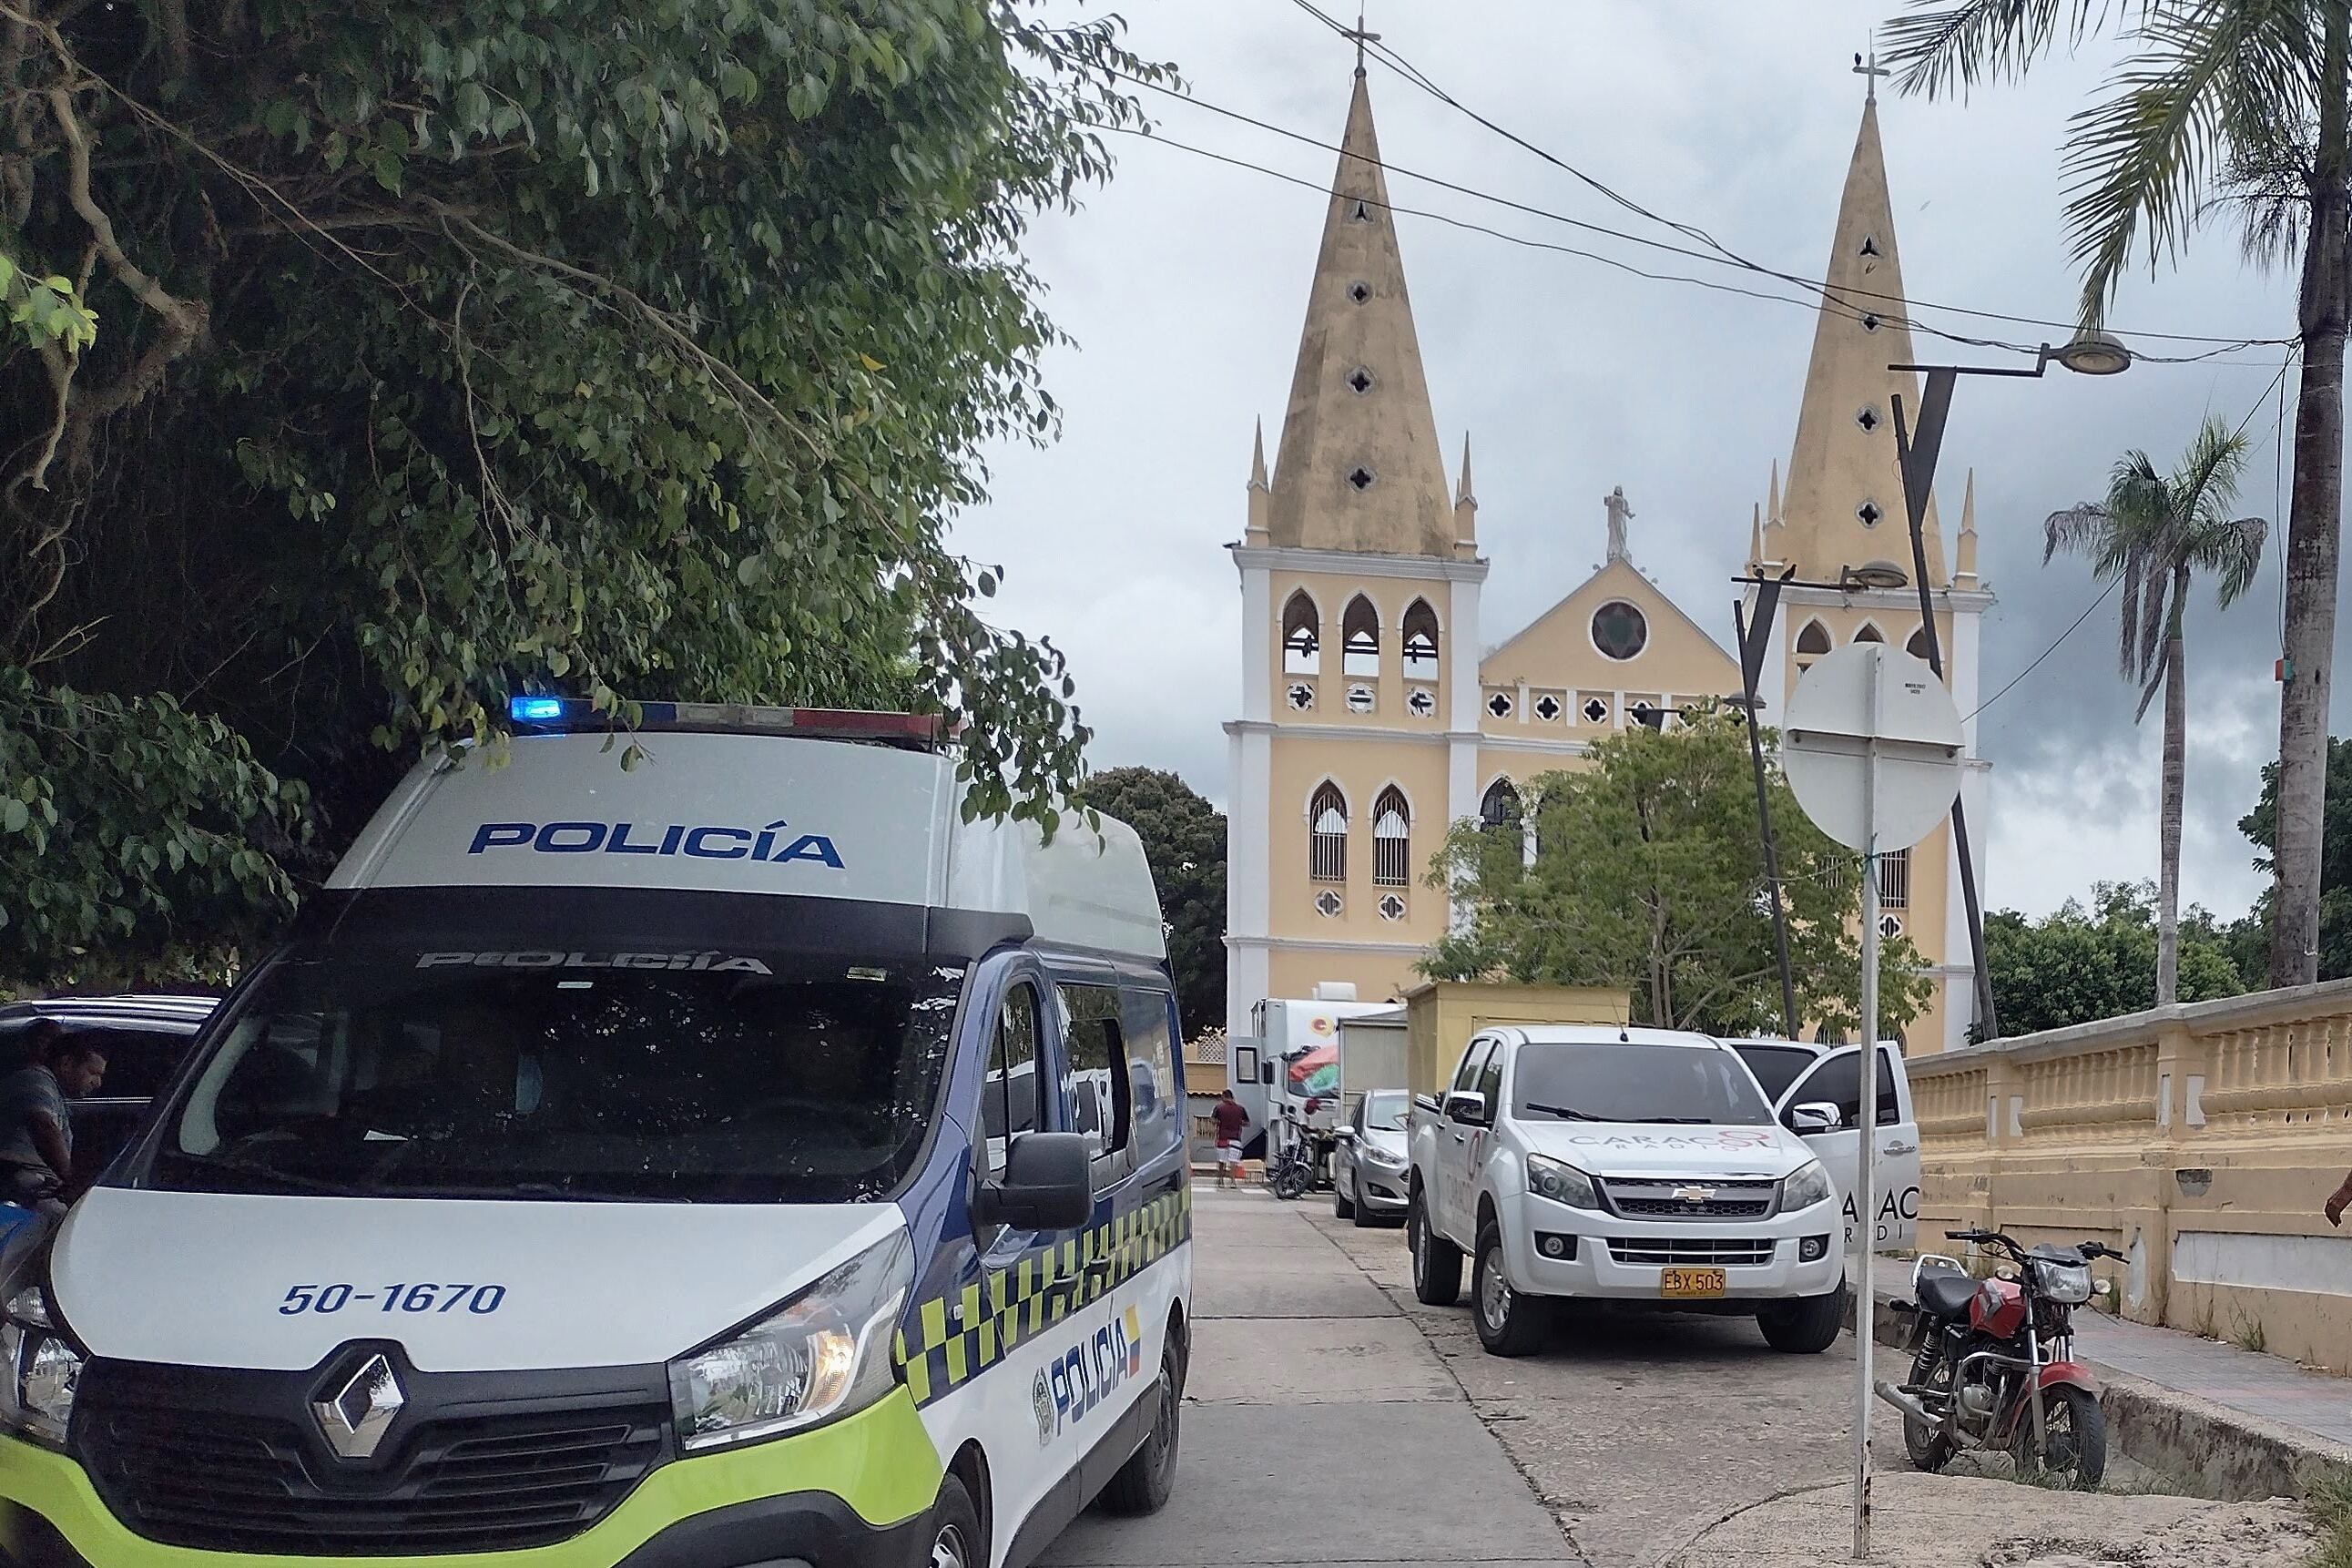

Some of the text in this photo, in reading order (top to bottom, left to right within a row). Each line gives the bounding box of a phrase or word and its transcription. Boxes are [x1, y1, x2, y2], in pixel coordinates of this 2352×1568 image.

[467, 820, 846, 870] POLICÍA
[1665, 1274, 1723, 1290] EBX 503
[279, 1283, 507, 1315] 50-1670
